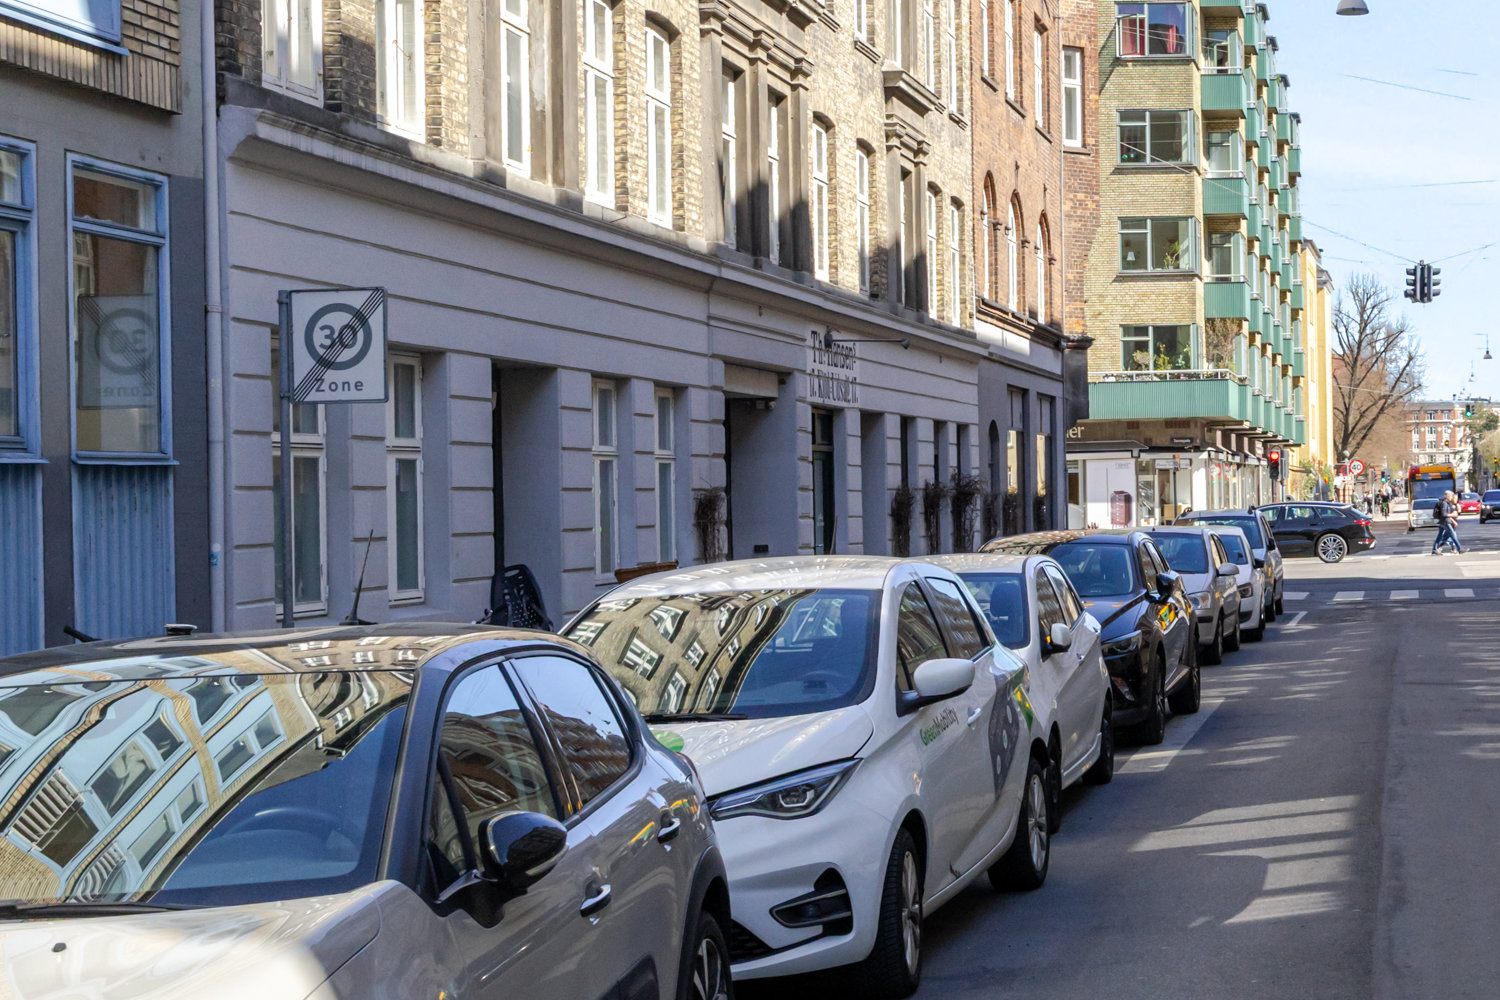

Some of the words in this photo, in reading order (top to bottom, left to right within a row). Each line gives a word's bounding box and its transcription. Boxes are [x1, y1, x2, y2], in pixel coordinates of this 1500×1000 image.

[318, 324, 358, 350] 30
[314, 377, 365, 393] Zone
[1351, 463, 1362, 471] 40
